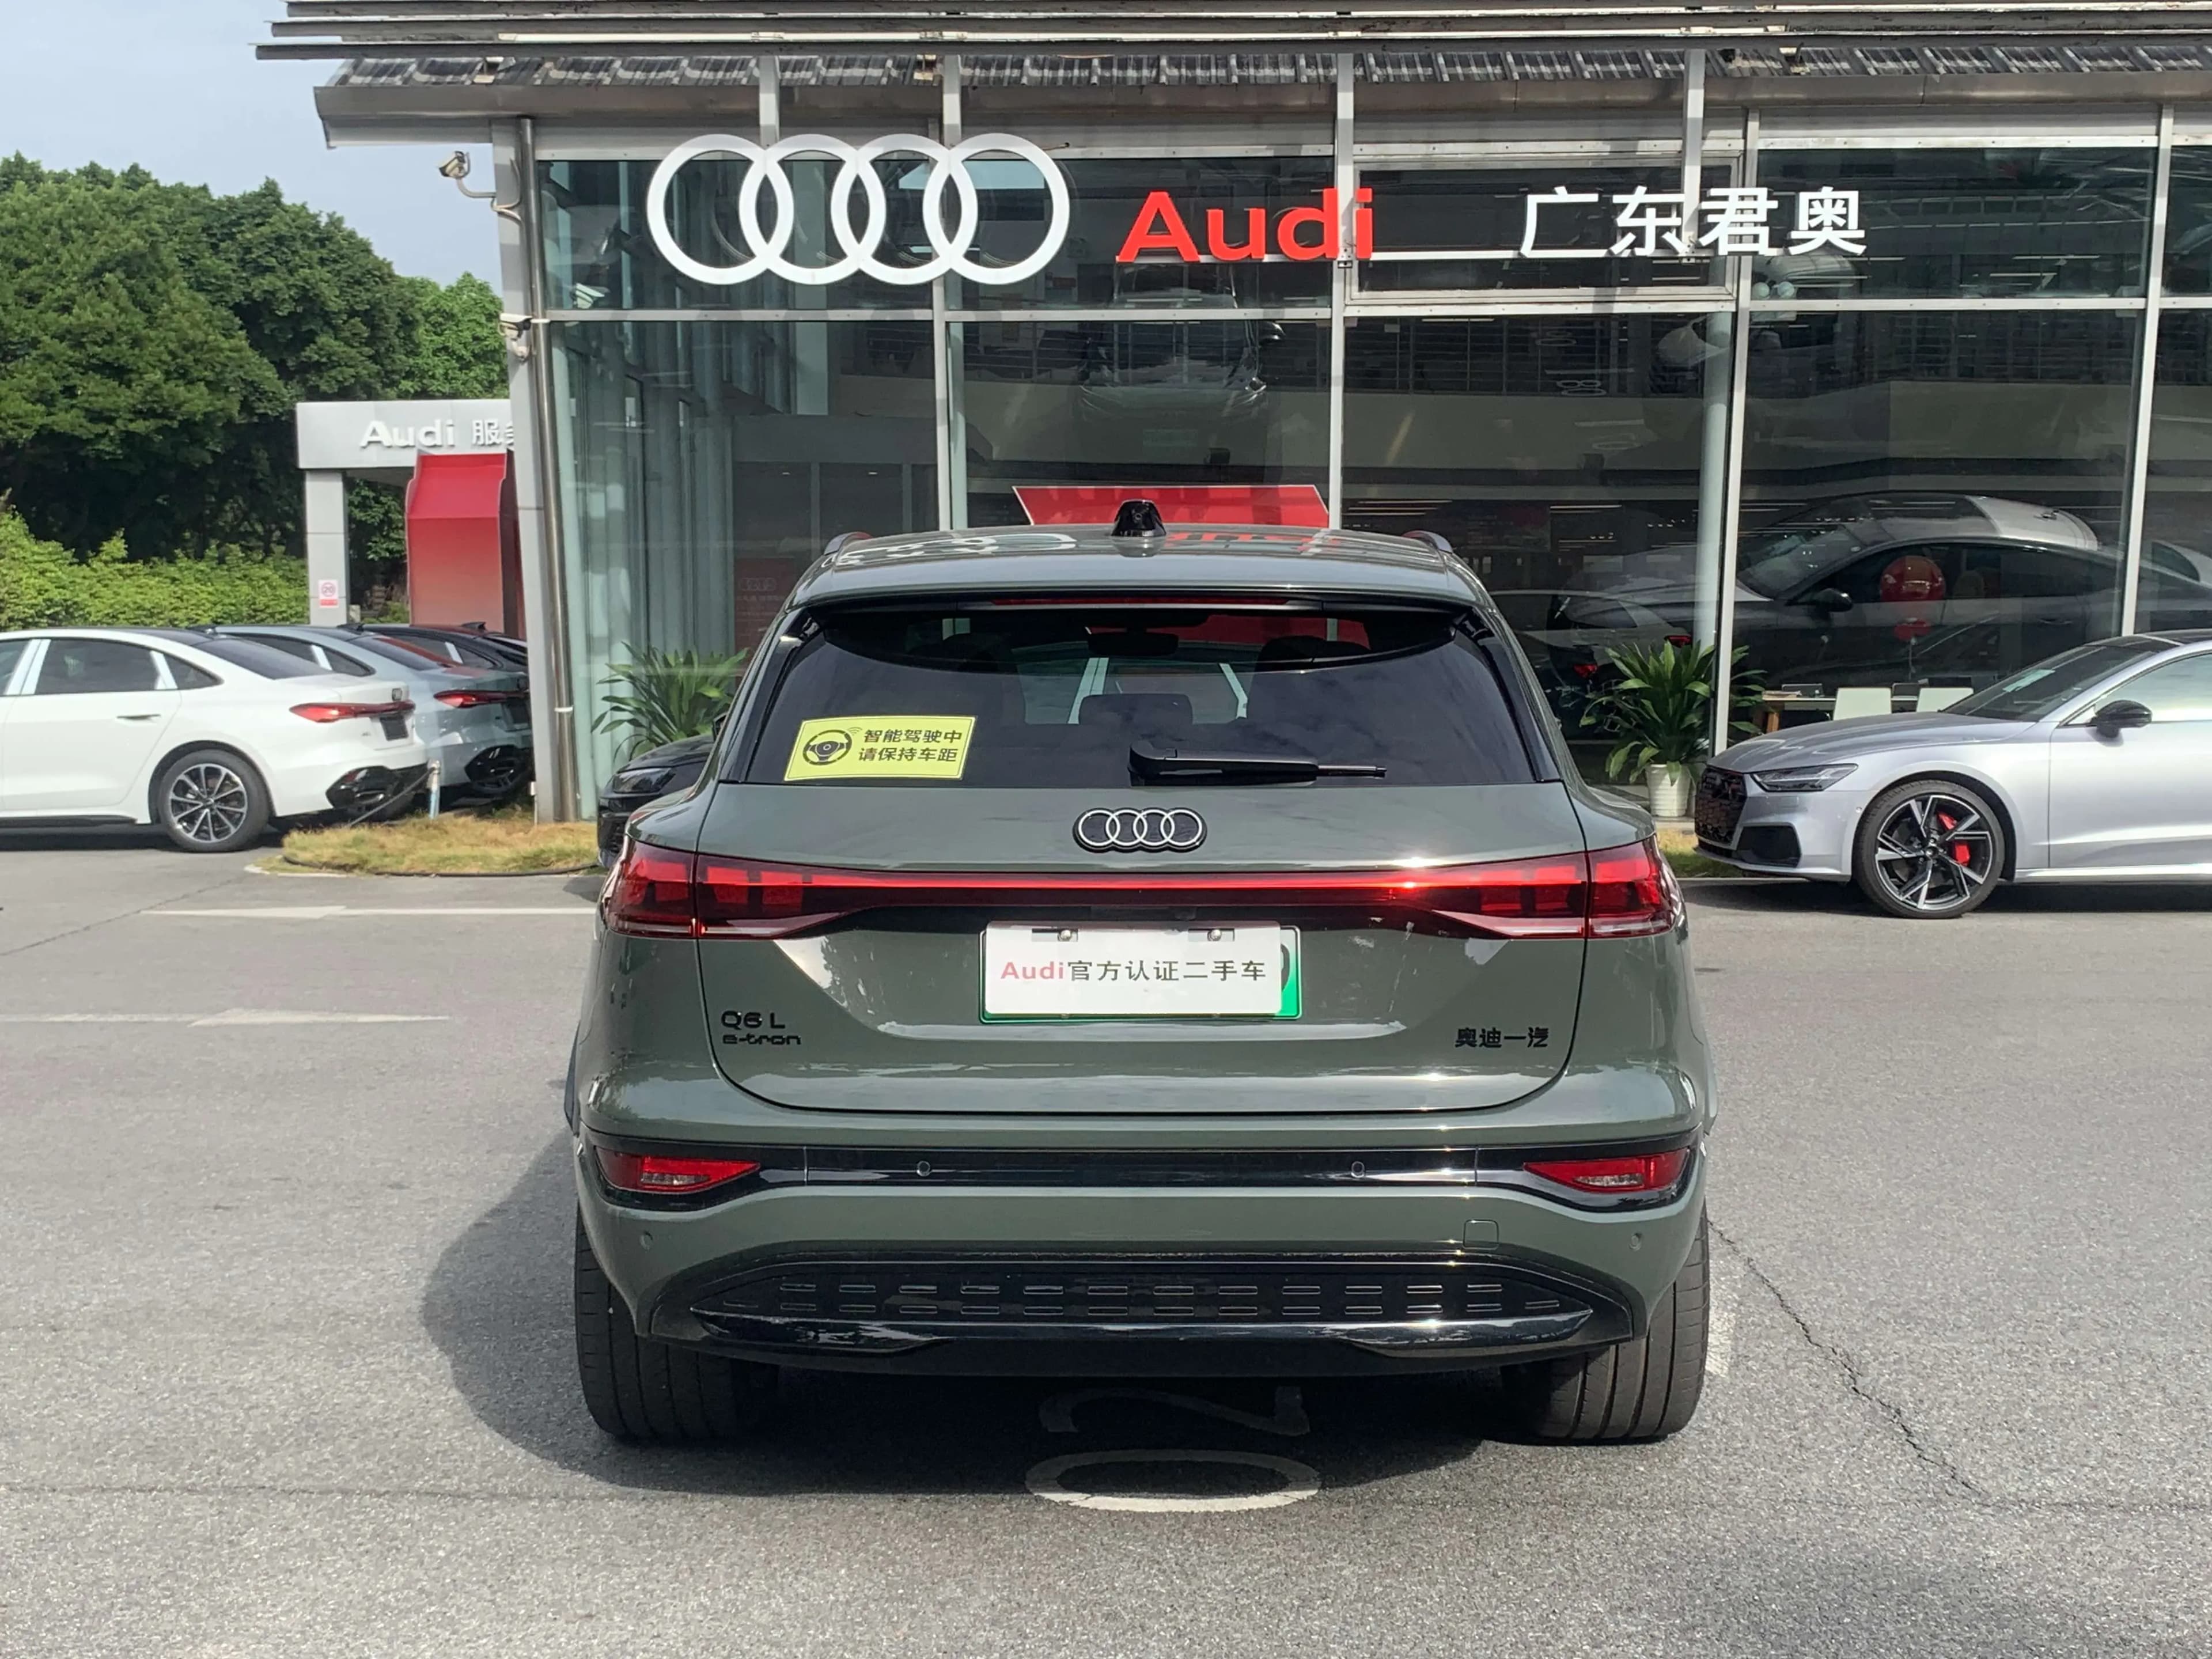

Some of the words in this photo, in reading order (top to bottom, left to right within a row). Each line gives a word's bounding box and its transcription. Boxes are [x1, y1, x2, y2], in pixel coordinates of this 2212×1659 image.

[1115, 188, 1373, 263] Audi
[1519, 185, 1868, 258] 广东君奥
[359, 419, 455, 448] Audi
[864, 729, 963, 744] 智能驾驶中
[858, 747, 959, 762] 请保持车距
[722, 1010, 763, 1030] Q6
[770, 1013, 786, 1029] L
[722, 1033, 801, 1045] e-tron
[1455, 1027, 1549, 1048] 奥迪一汽
